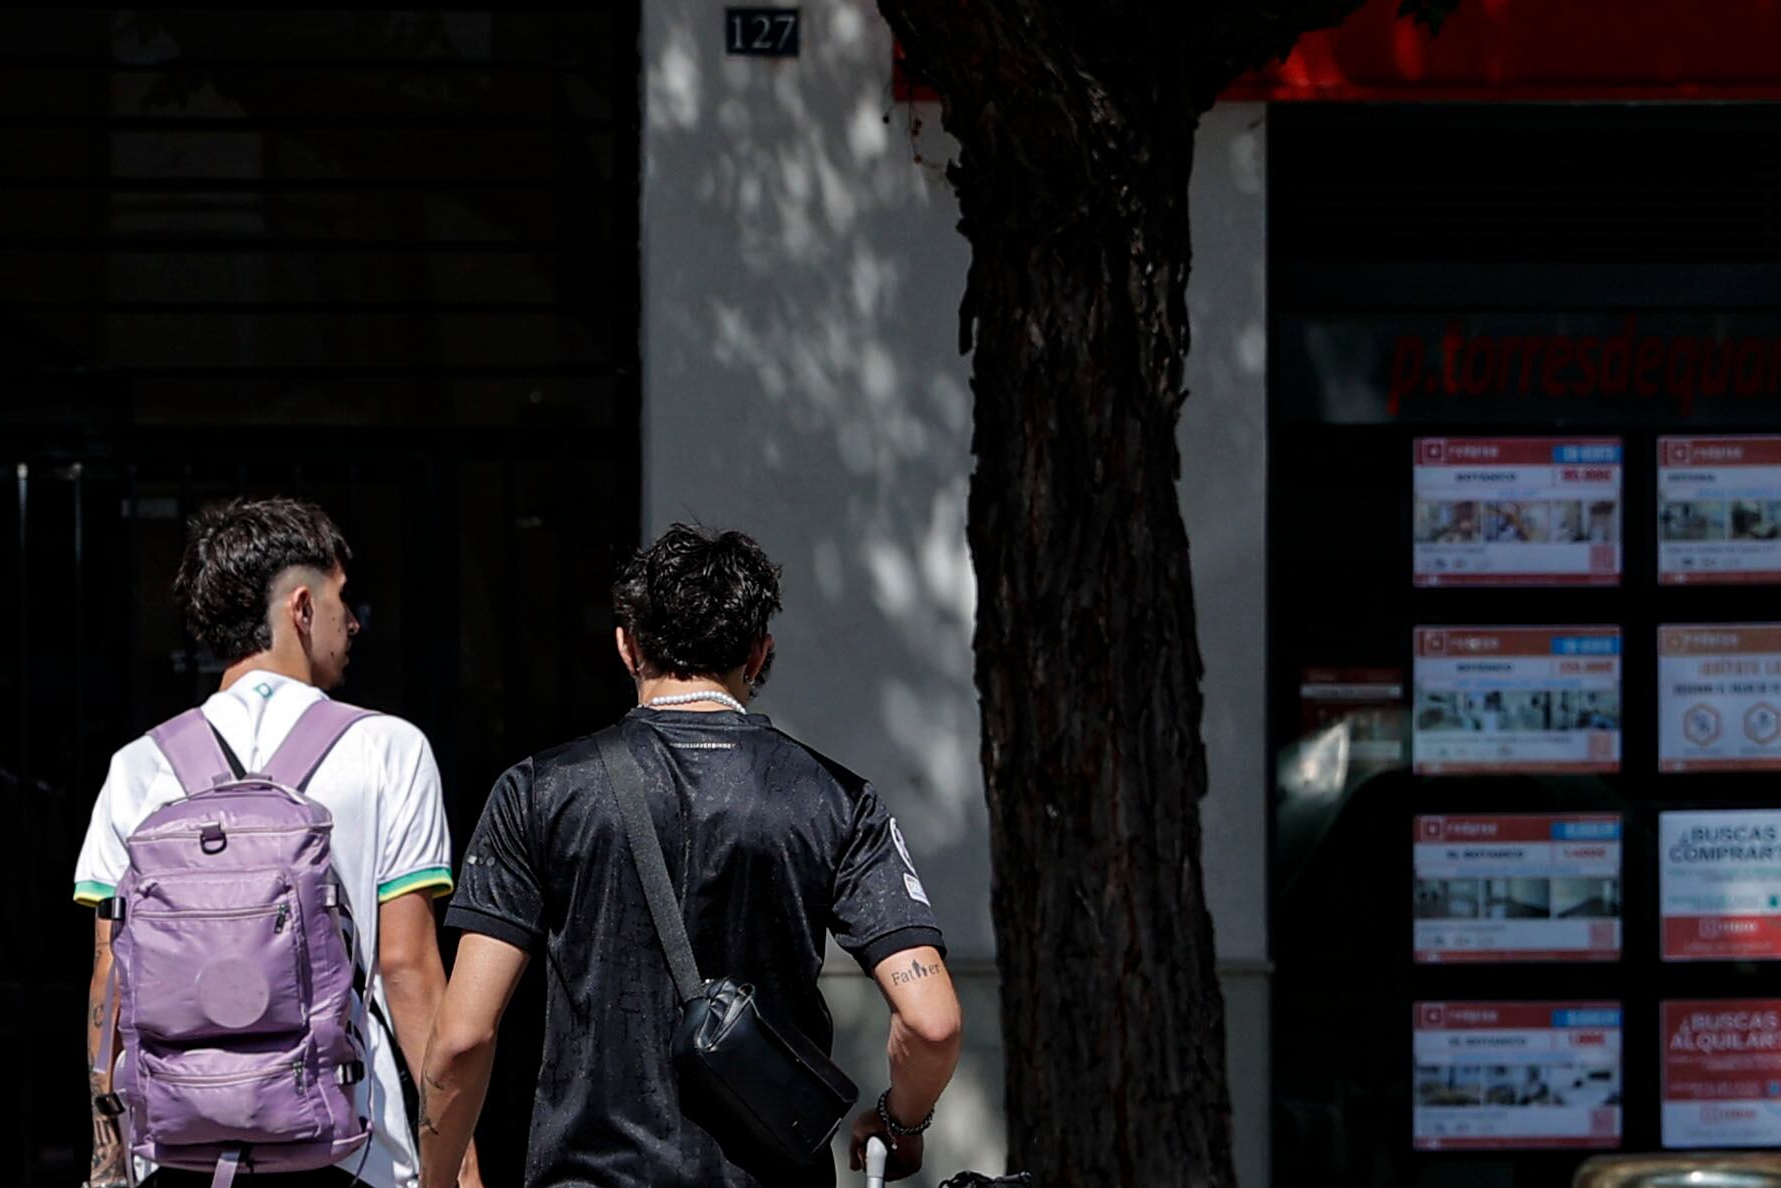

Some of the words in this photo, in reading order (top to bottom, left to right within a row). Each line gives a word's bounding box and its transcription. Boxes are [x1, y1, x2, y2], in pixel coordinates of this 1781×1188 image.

[731, 15, 795, 49] 127
[1679, 825, 1777, 848] ¿BUSCAS
[891, 959, 940, 986] Father
[1679, 1012, 1778, 1037] ¿BUSCAS
